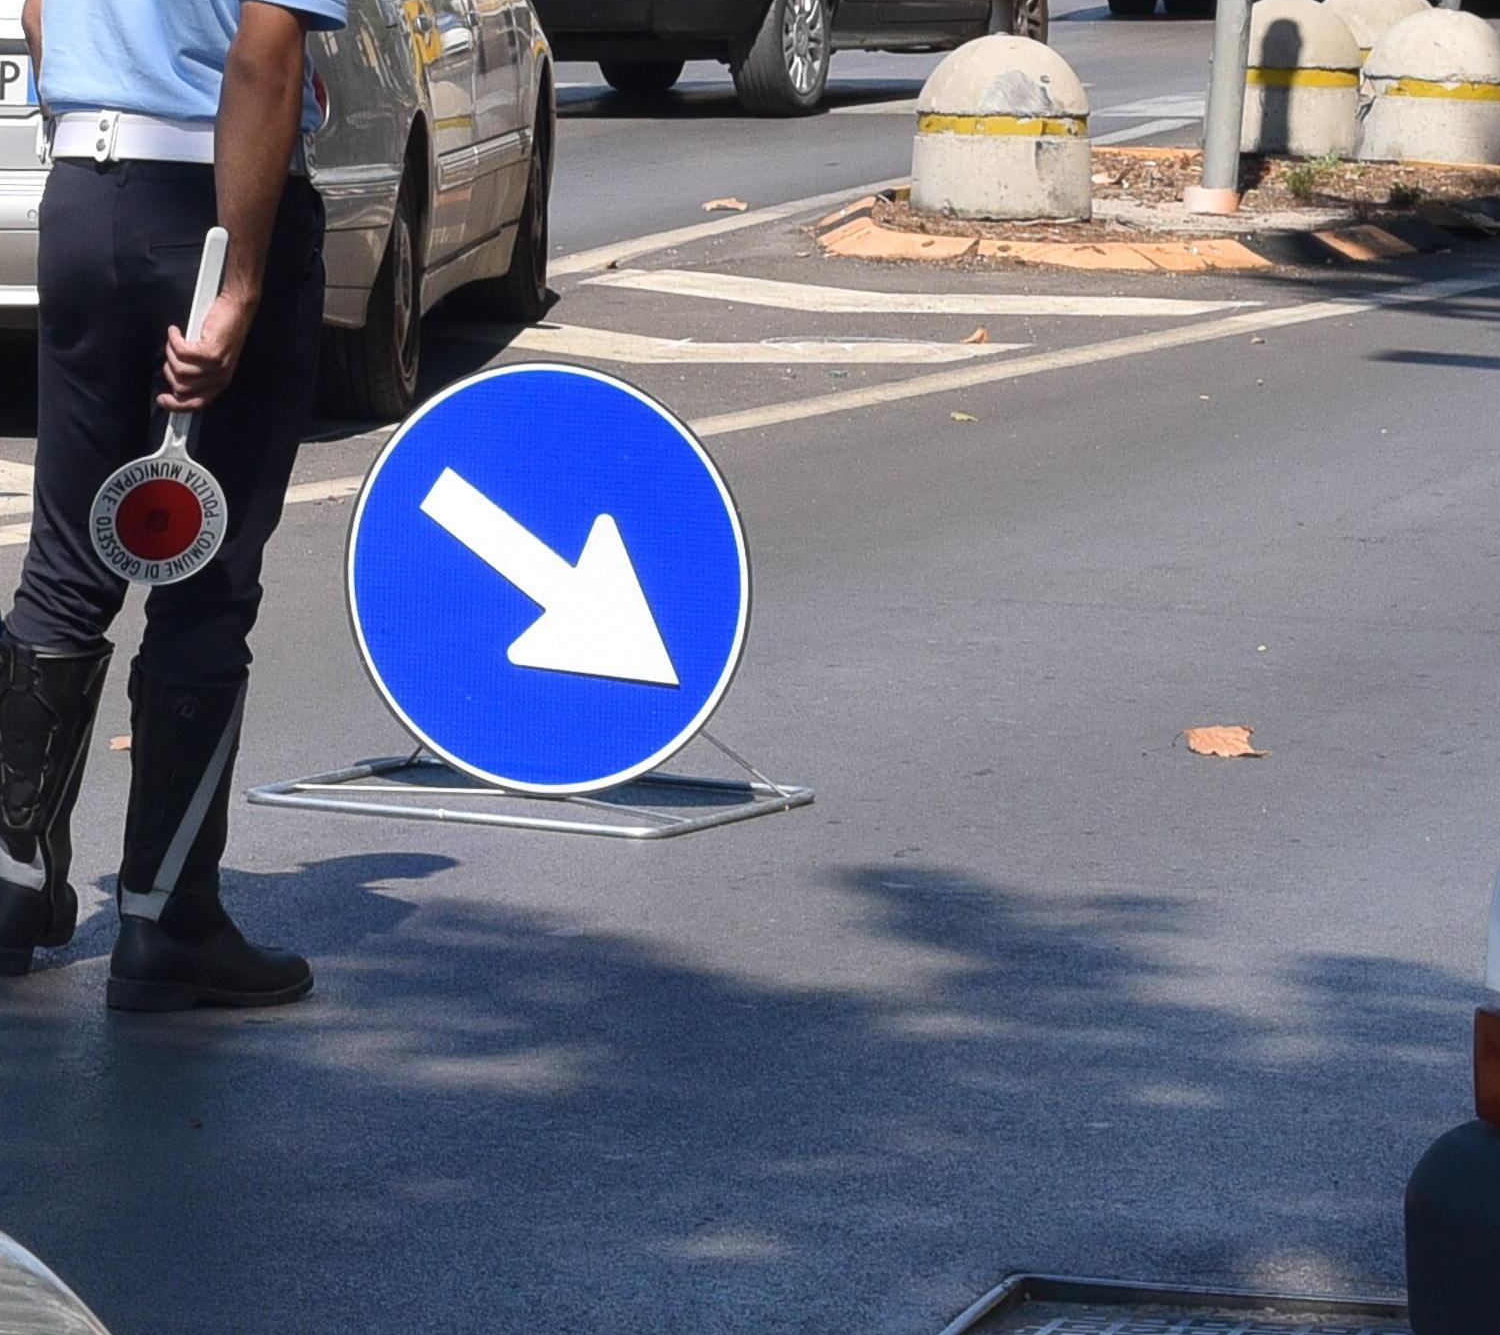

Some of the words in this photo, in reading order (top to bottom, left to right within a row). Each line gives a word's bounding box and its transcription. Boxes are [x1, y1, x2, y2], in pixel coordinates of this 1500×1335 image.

[102, 464, 183, 506] MUNICIPALE
[185, 469, 219, 519] POLIZIA
[96, 516, 141, 576] GROSSETO
[166, 530, 216, 578] COMUNE
[144, 564, 160, 579] DI
